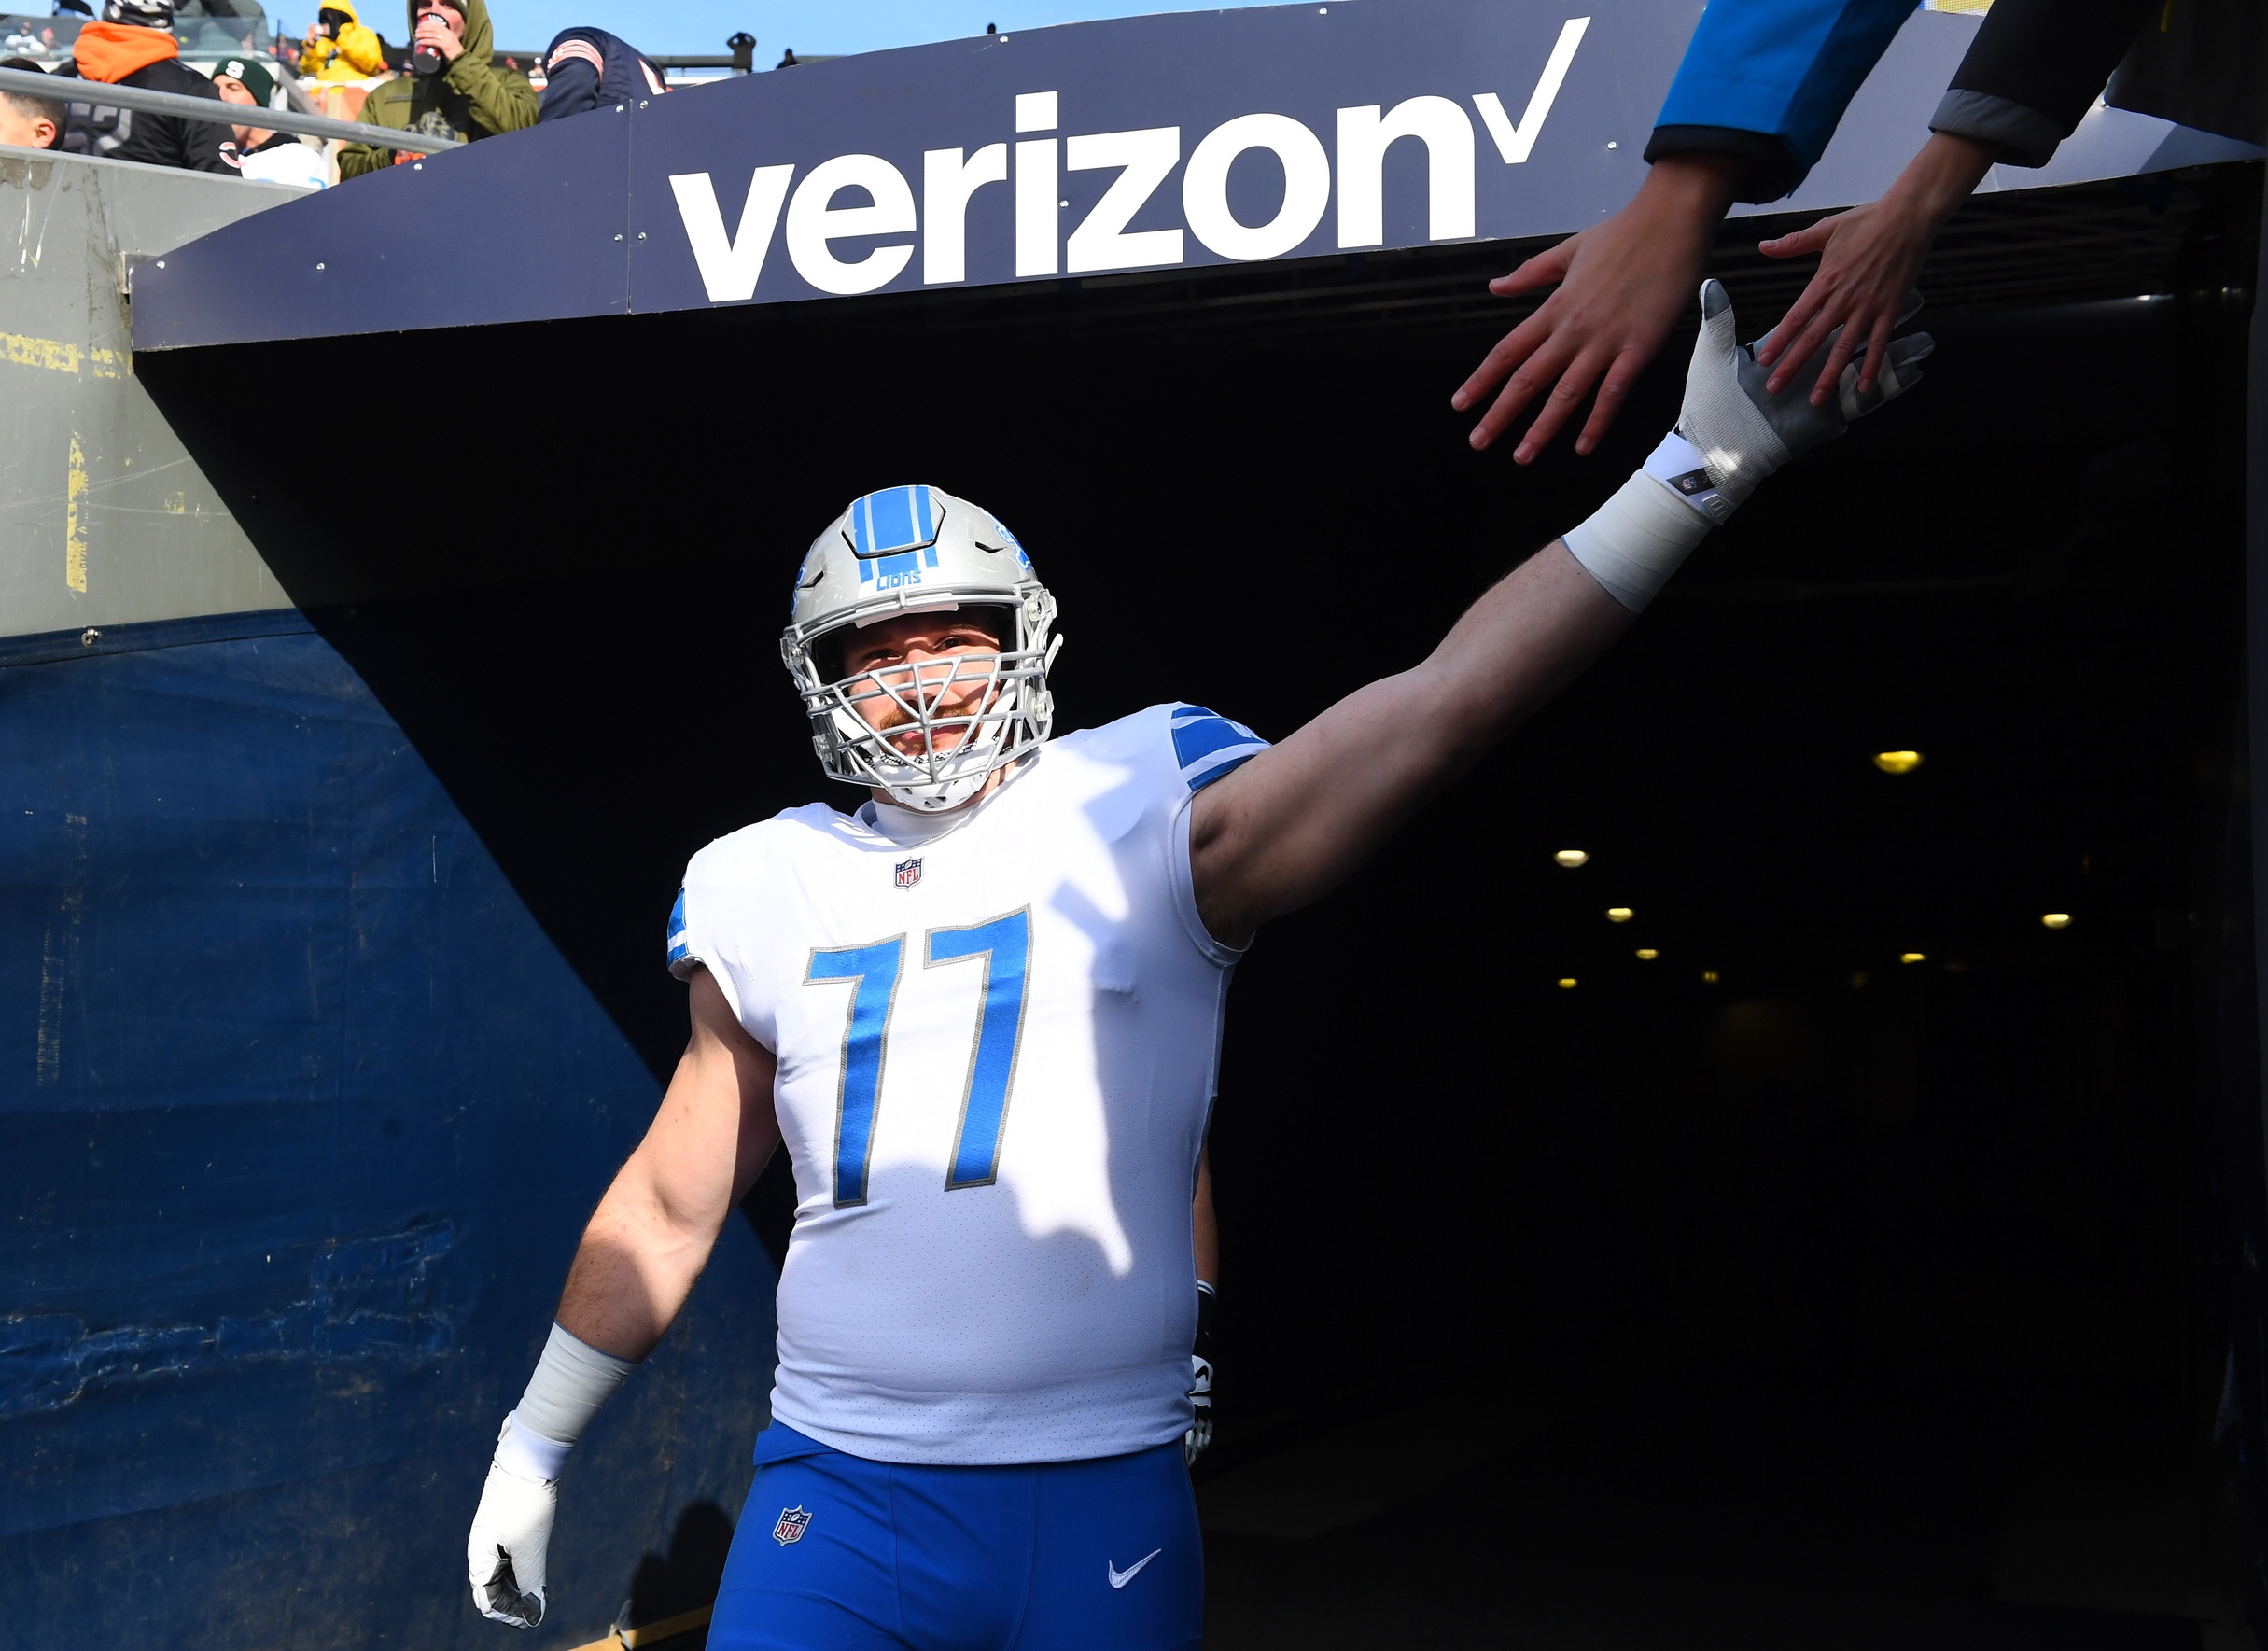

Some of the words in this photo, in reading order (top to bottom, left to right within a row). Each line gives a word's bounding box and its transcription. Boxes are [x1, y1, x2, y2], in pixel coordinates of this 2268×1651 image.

[668, 90, 1476, 303] verizon
[897, 868, 919, 885] NFL
[802, 902, 1034, 1210] 77
[777, 1522, 800, 1539] NFL
